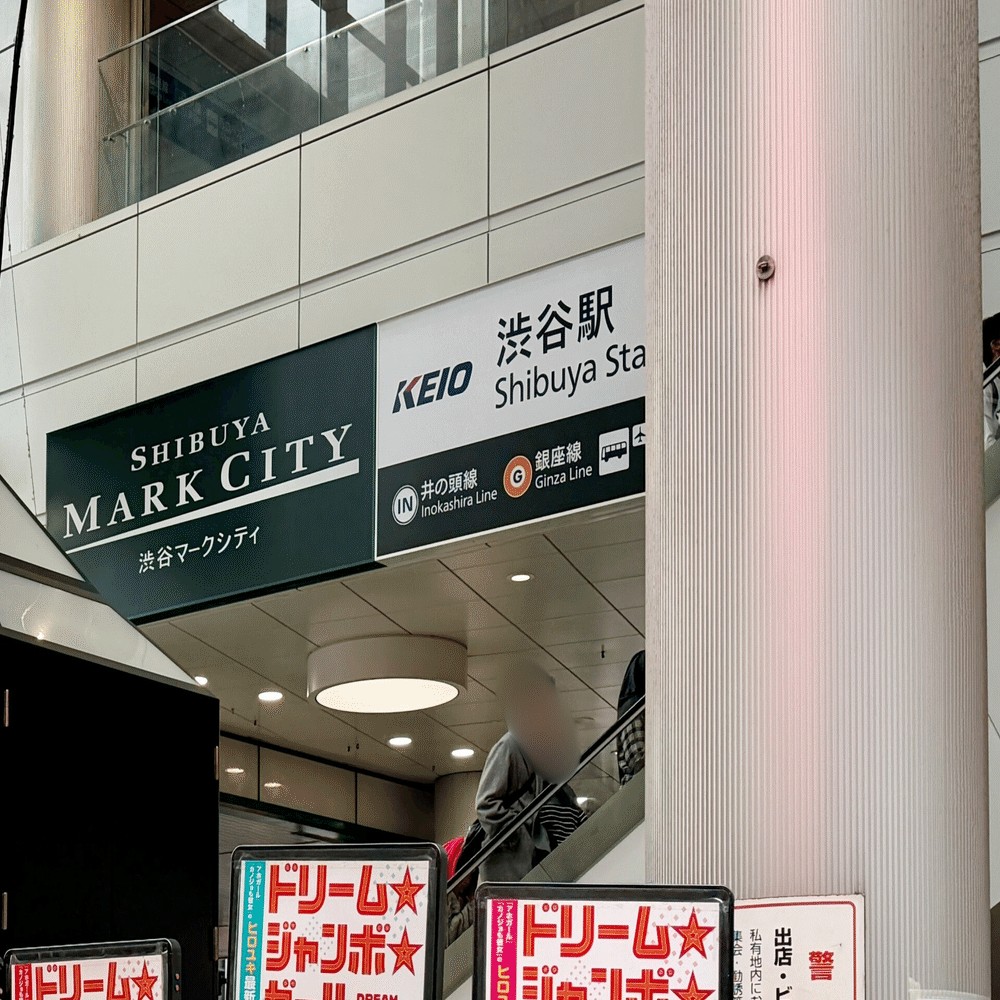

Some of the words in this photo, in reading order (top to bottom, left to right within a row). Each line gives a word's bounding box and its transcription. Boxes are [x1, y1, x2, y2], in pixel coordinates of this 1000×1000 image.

[495, 285, 615, 368] 渋谷駅
[392, 361, 474, 415] KEIO
[494, 360, 597, 410] Shibuya
[130, 412, 271, 473] SHIBUYA
[535, 441, 582, 472] 銀座線
[62, 467, 205, 540] MARK
[219, 422, 353, 495] CITY
[421, 468, 478, 501] 井の頭線
[513, 469, 522, 484] G
[535, 473, 567, 490] Ginza
[569, 464, 593, 481] Line
[397, 497, 413, 515] IN
[421, 494, 473, 519] Inokashira
[475, 489, 498, 505] Line
[137, 525, 262, 575] 渋谷マークシティ
[522, 903, 671, 959] ドリーム
